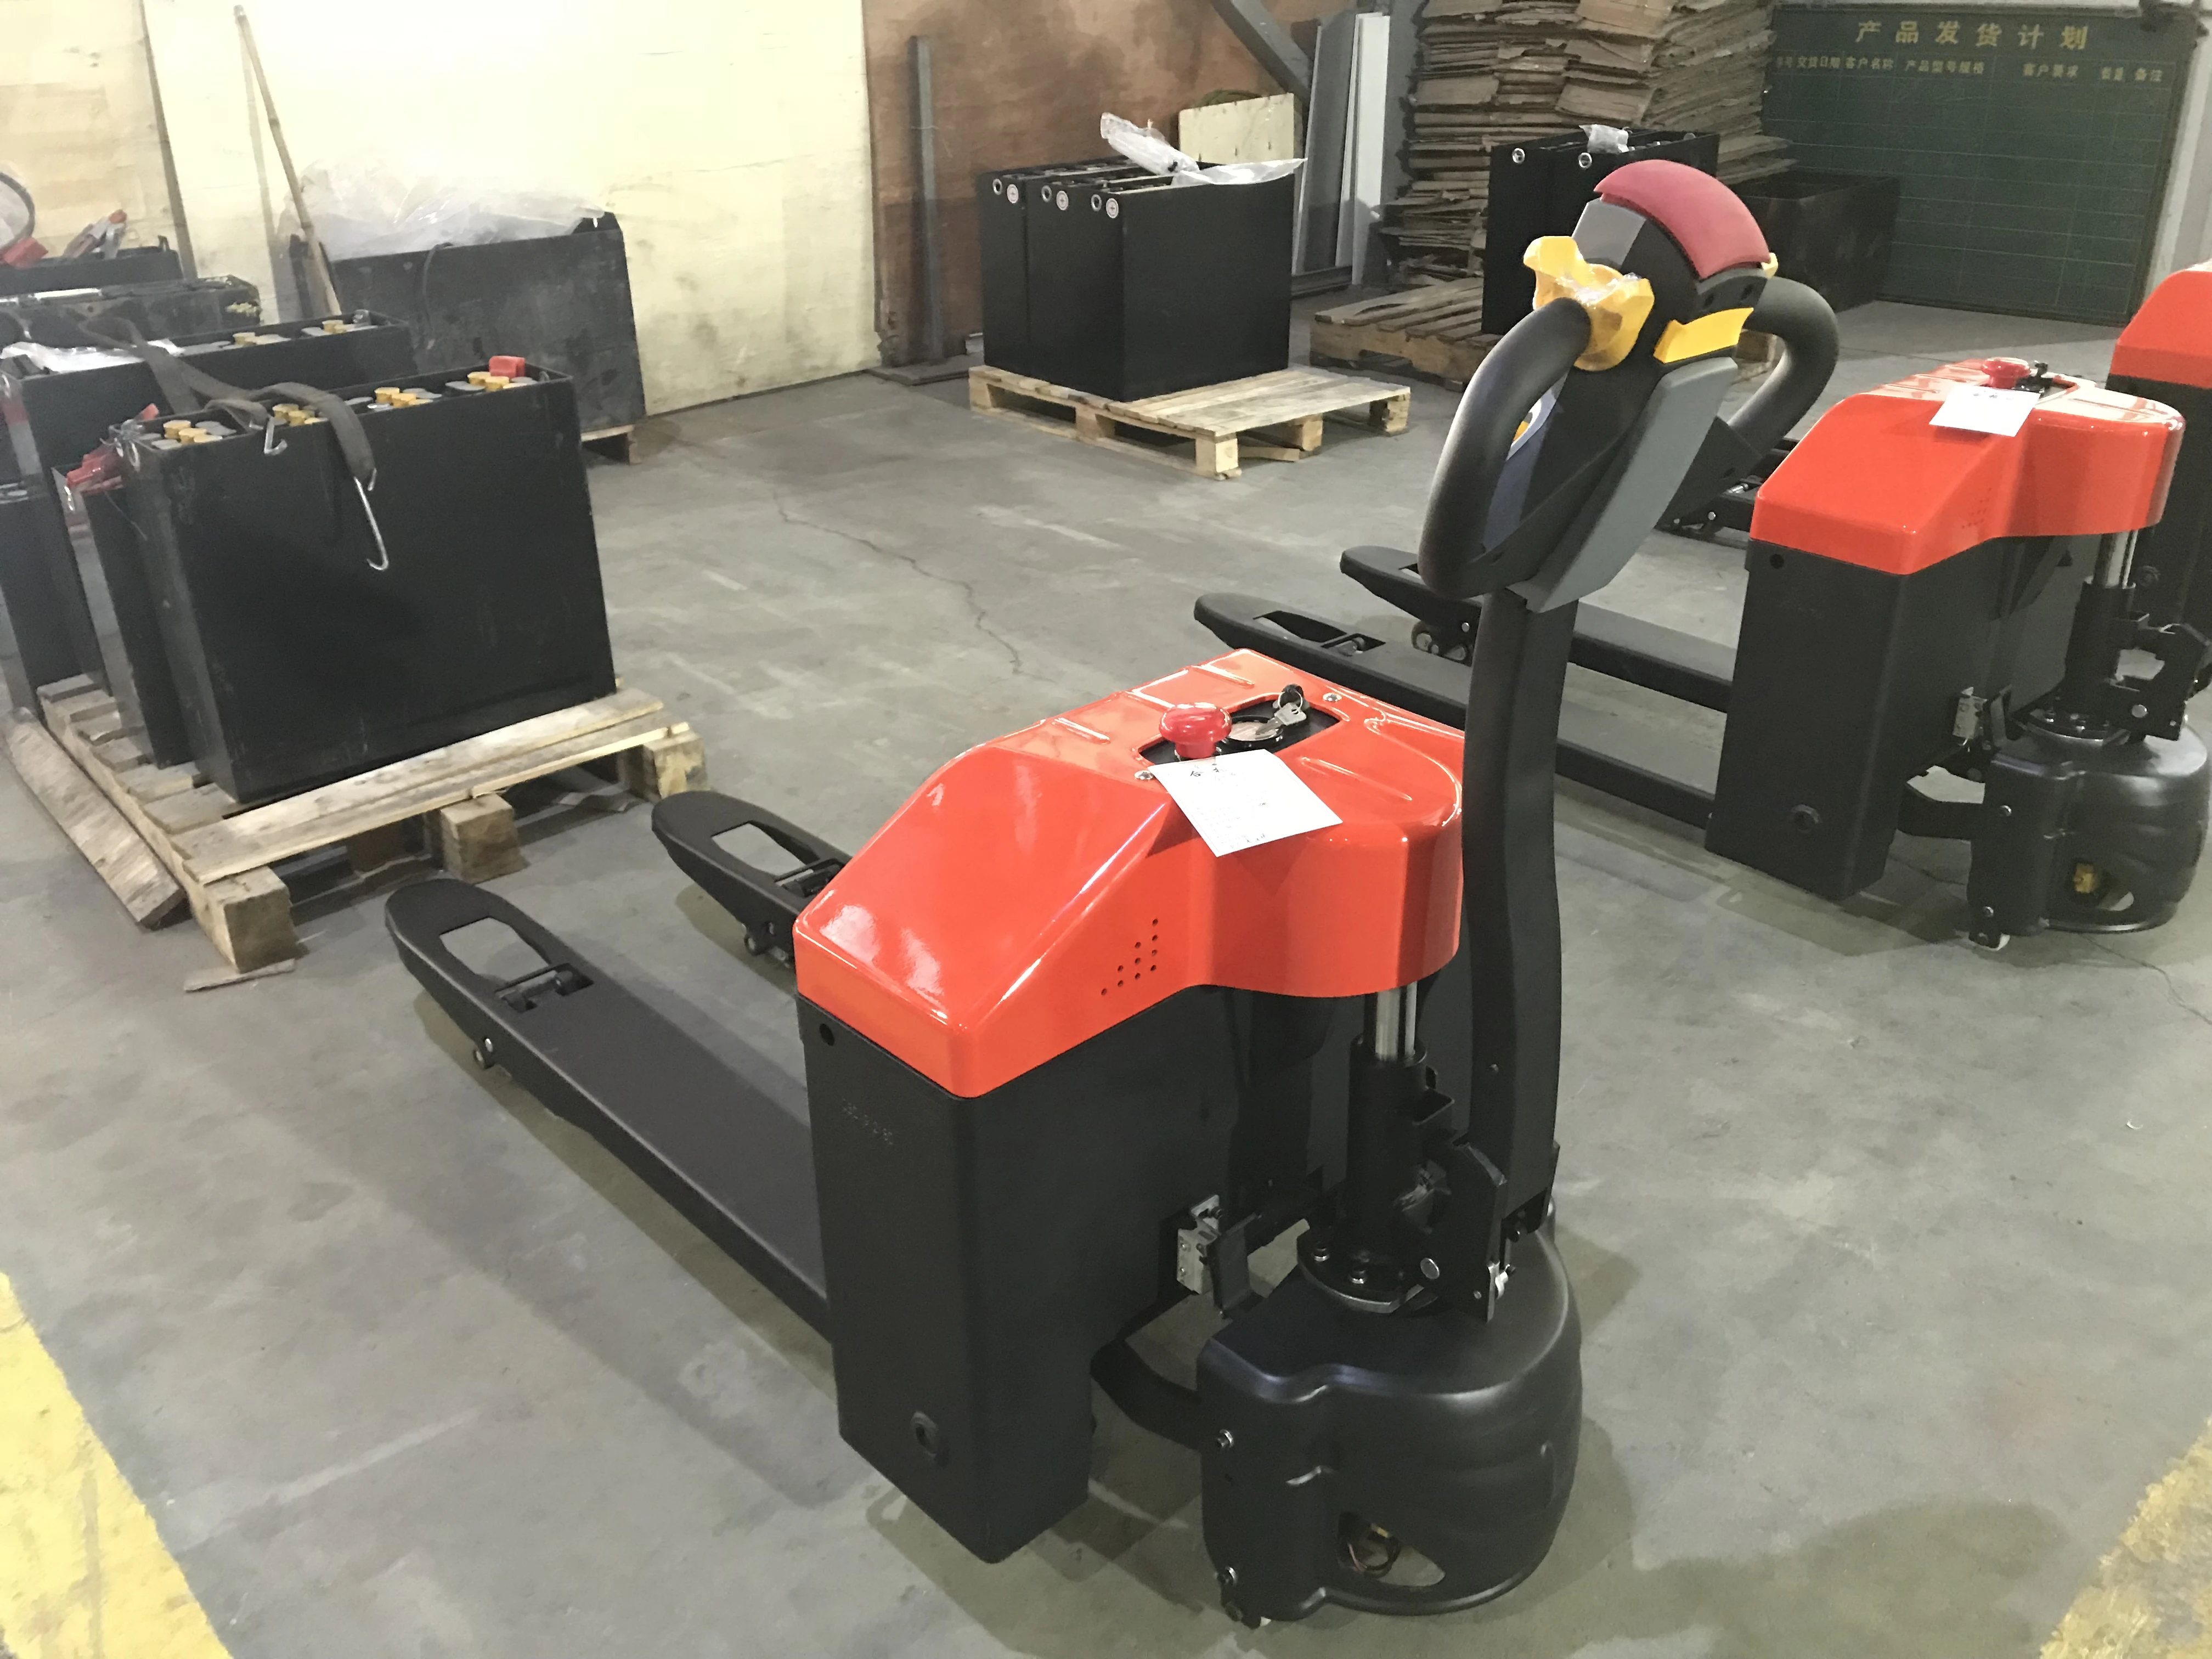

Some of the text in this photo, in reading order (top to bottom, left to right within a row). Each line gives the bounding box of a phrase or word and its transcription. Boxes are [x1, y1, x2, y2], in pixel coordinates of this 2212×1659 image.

[1855, 20, 2089, 50] 产品发货计划
